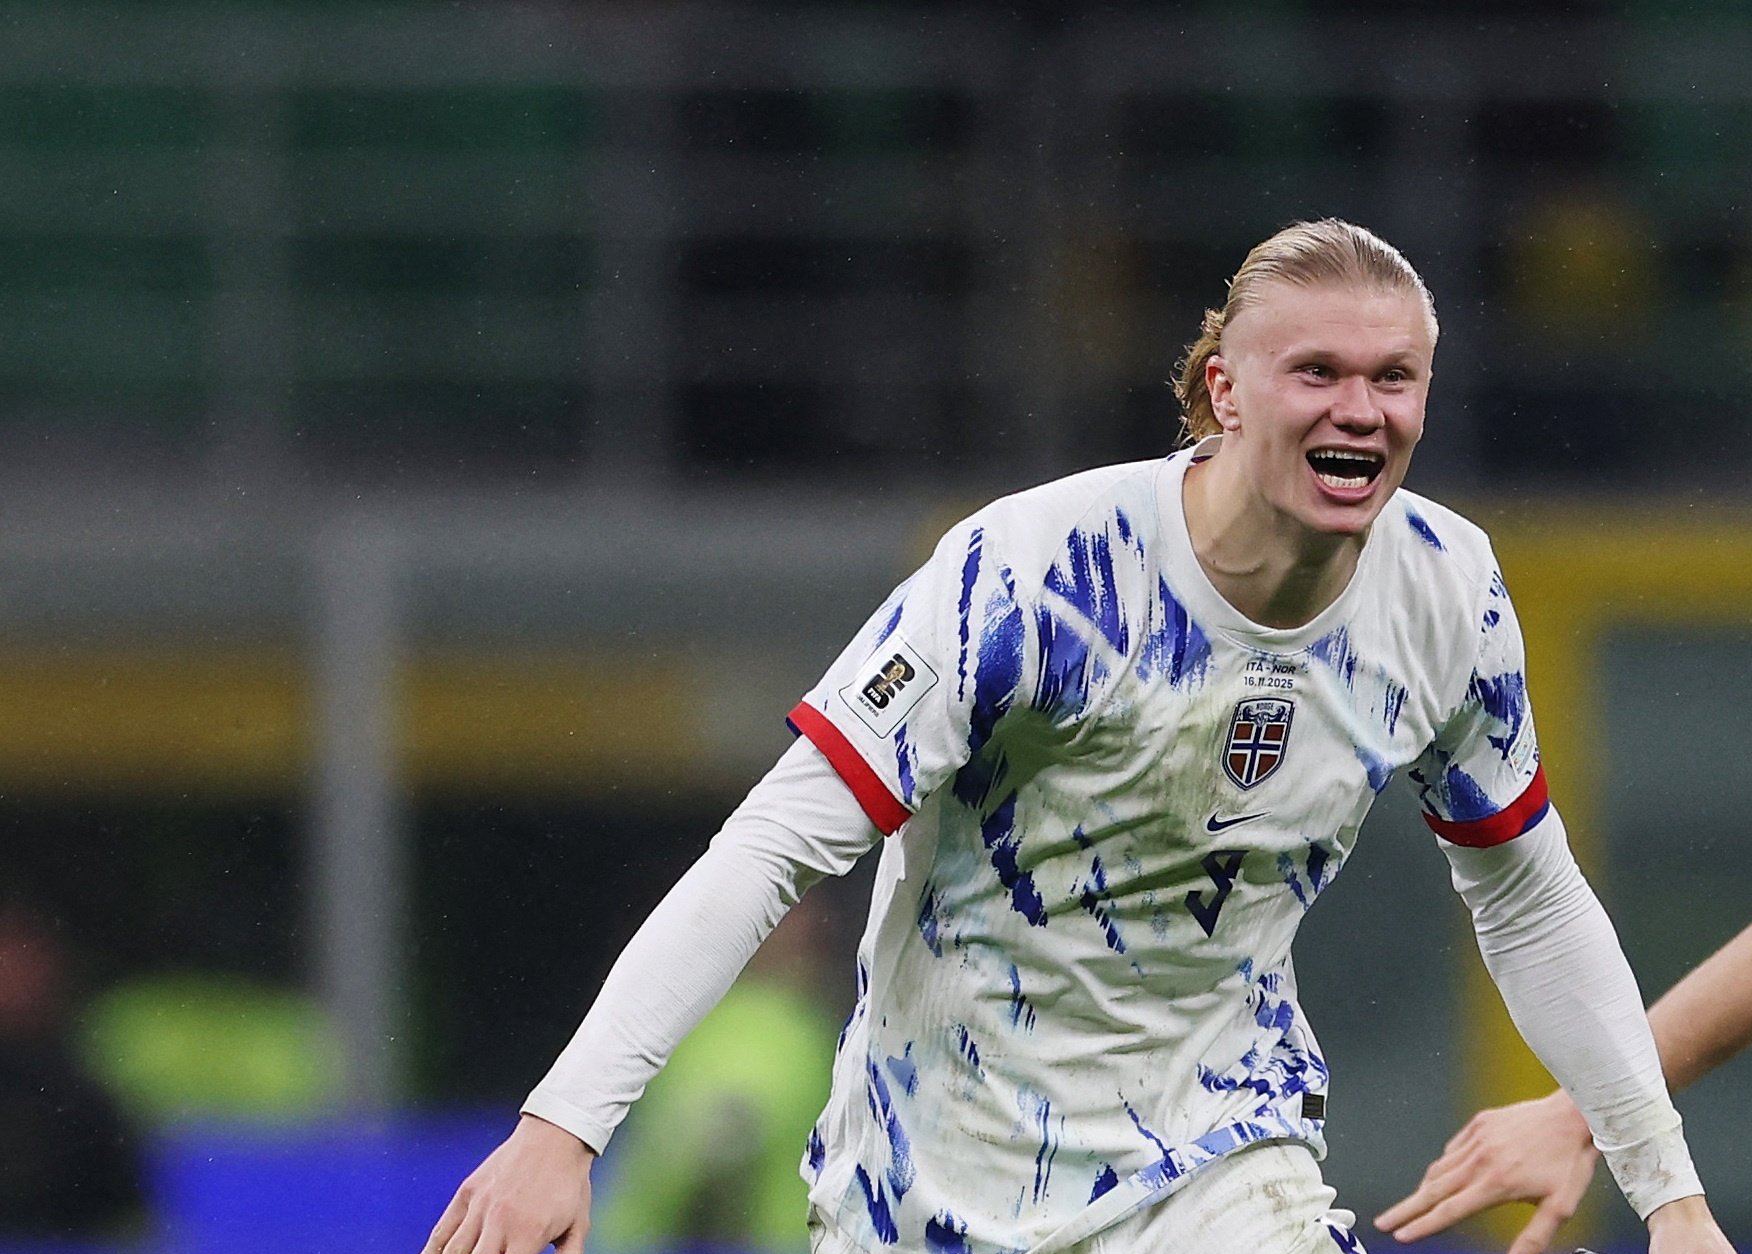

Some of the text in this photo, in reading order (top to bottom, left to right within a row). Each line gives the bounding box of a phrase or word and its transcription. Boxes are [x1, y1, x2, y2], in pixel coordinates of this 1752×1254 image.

[1246, 661, 1263, 672] ITA
[1271, 665, 1296, 674] NOR
[1244, 676, 1294, 688] 16.11.2025
